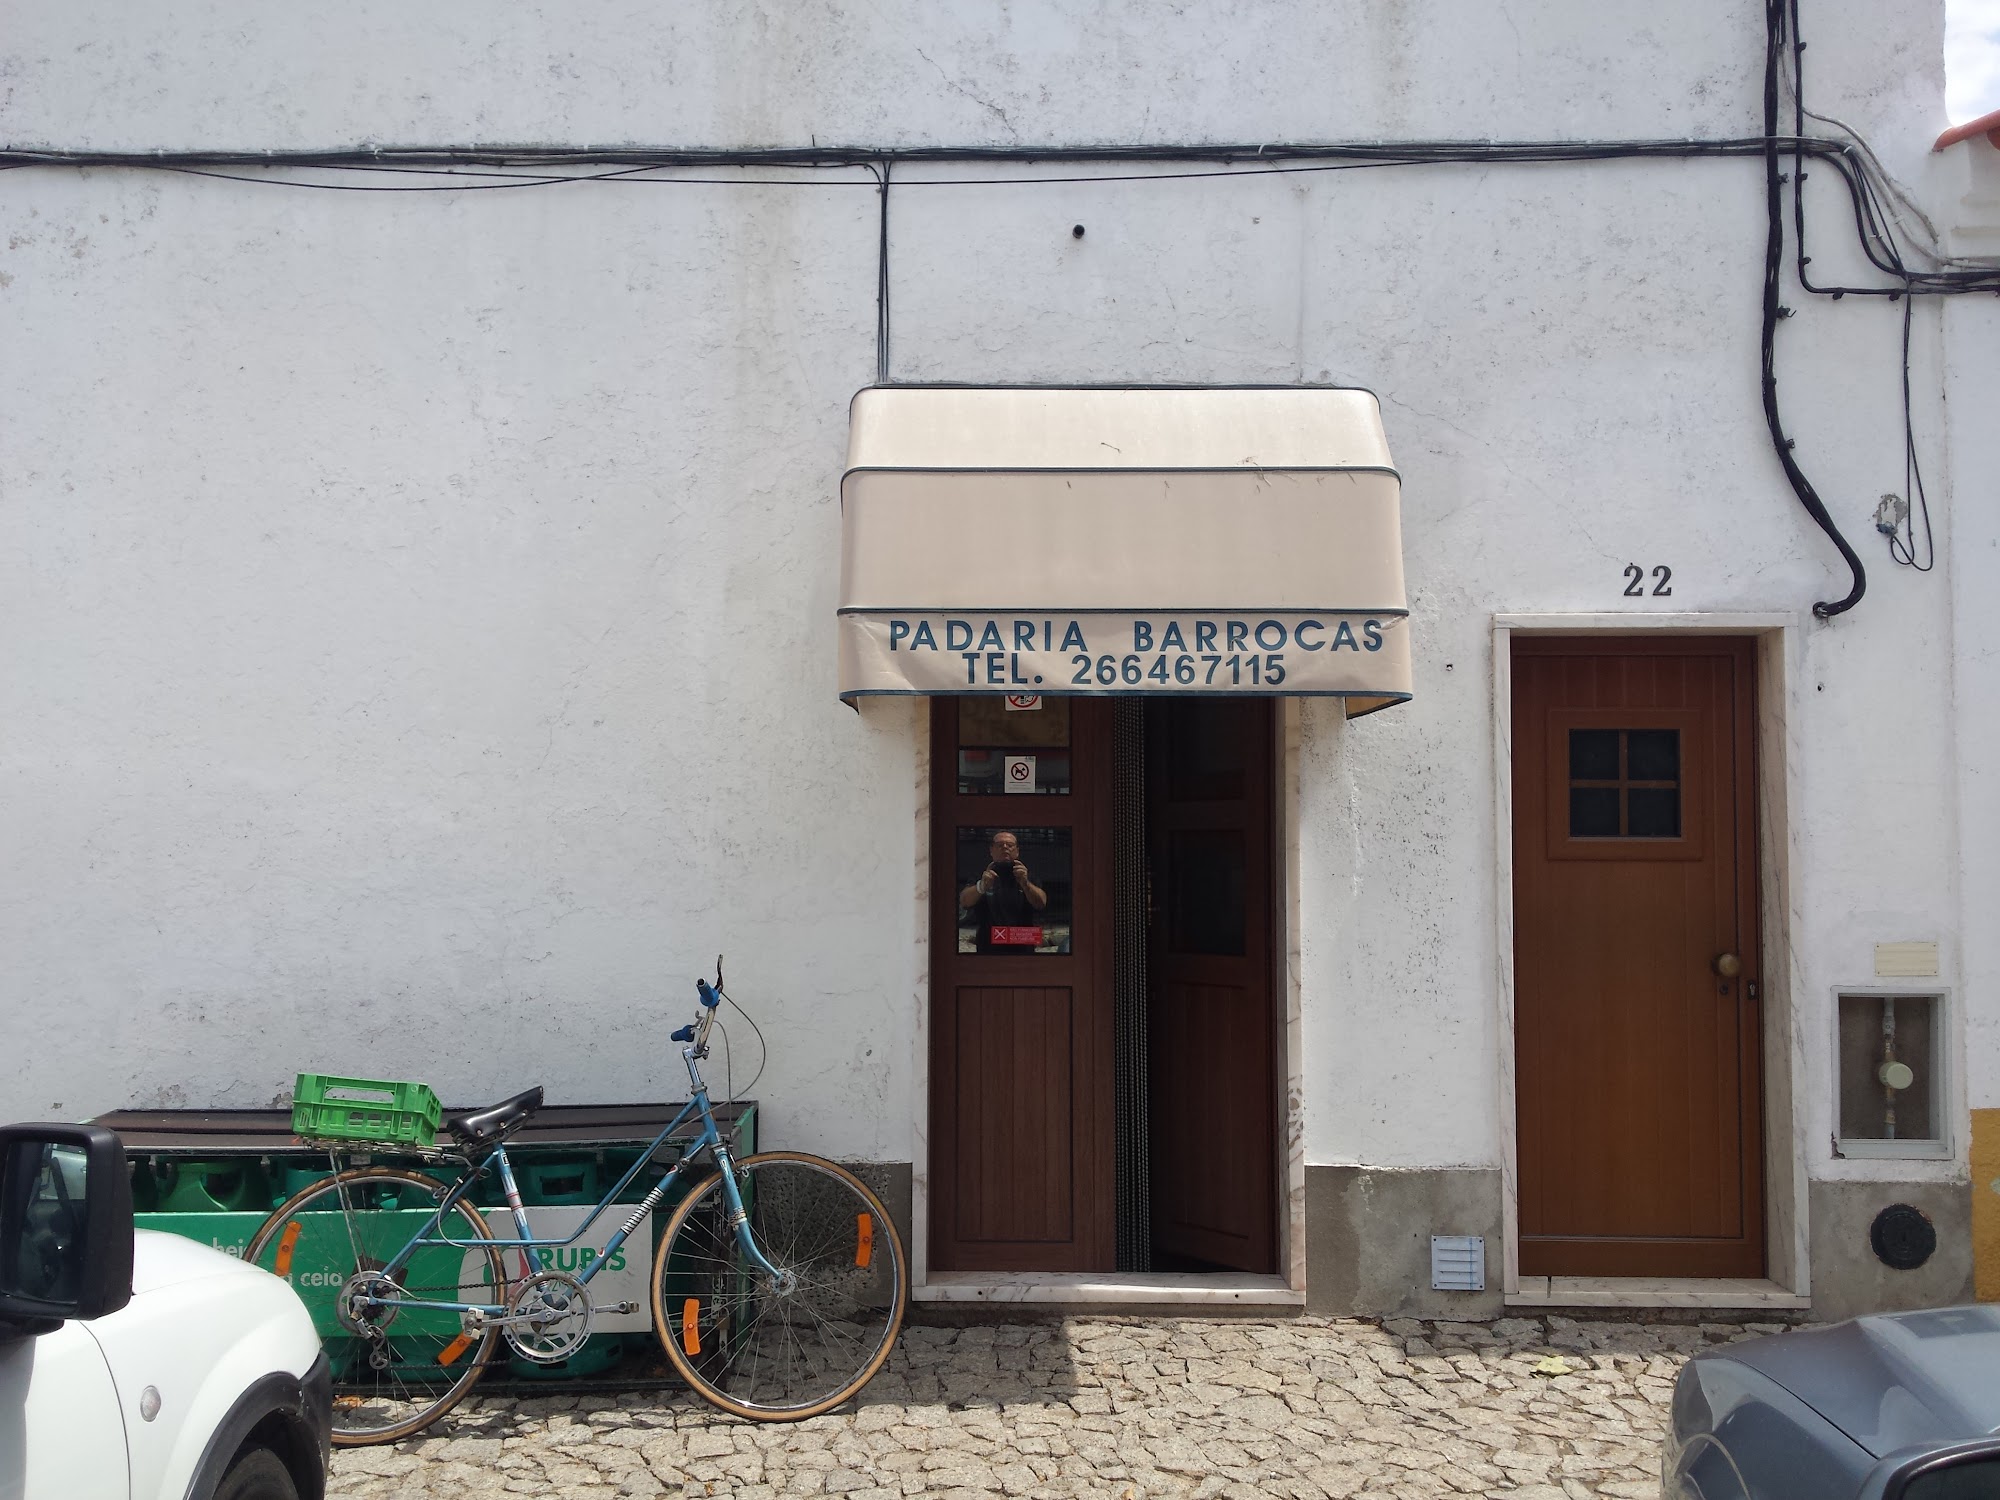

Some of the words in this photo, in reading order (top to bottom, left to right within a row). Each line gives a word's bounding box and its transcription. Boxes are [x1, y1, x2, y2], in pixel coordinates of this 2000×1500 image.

[1624, 565, 1671, 596] 22
[890, 620, 1088, 651] PADARIA
[1134, 620, 1383, 652] BARROCAS
[962, 653, 1043, 684] TEL.
[1071, 655, 1286, 685] 266467115
[537, 1247, 626, 1271] RUBS
[296, 1265, 343, 1287] ceia
